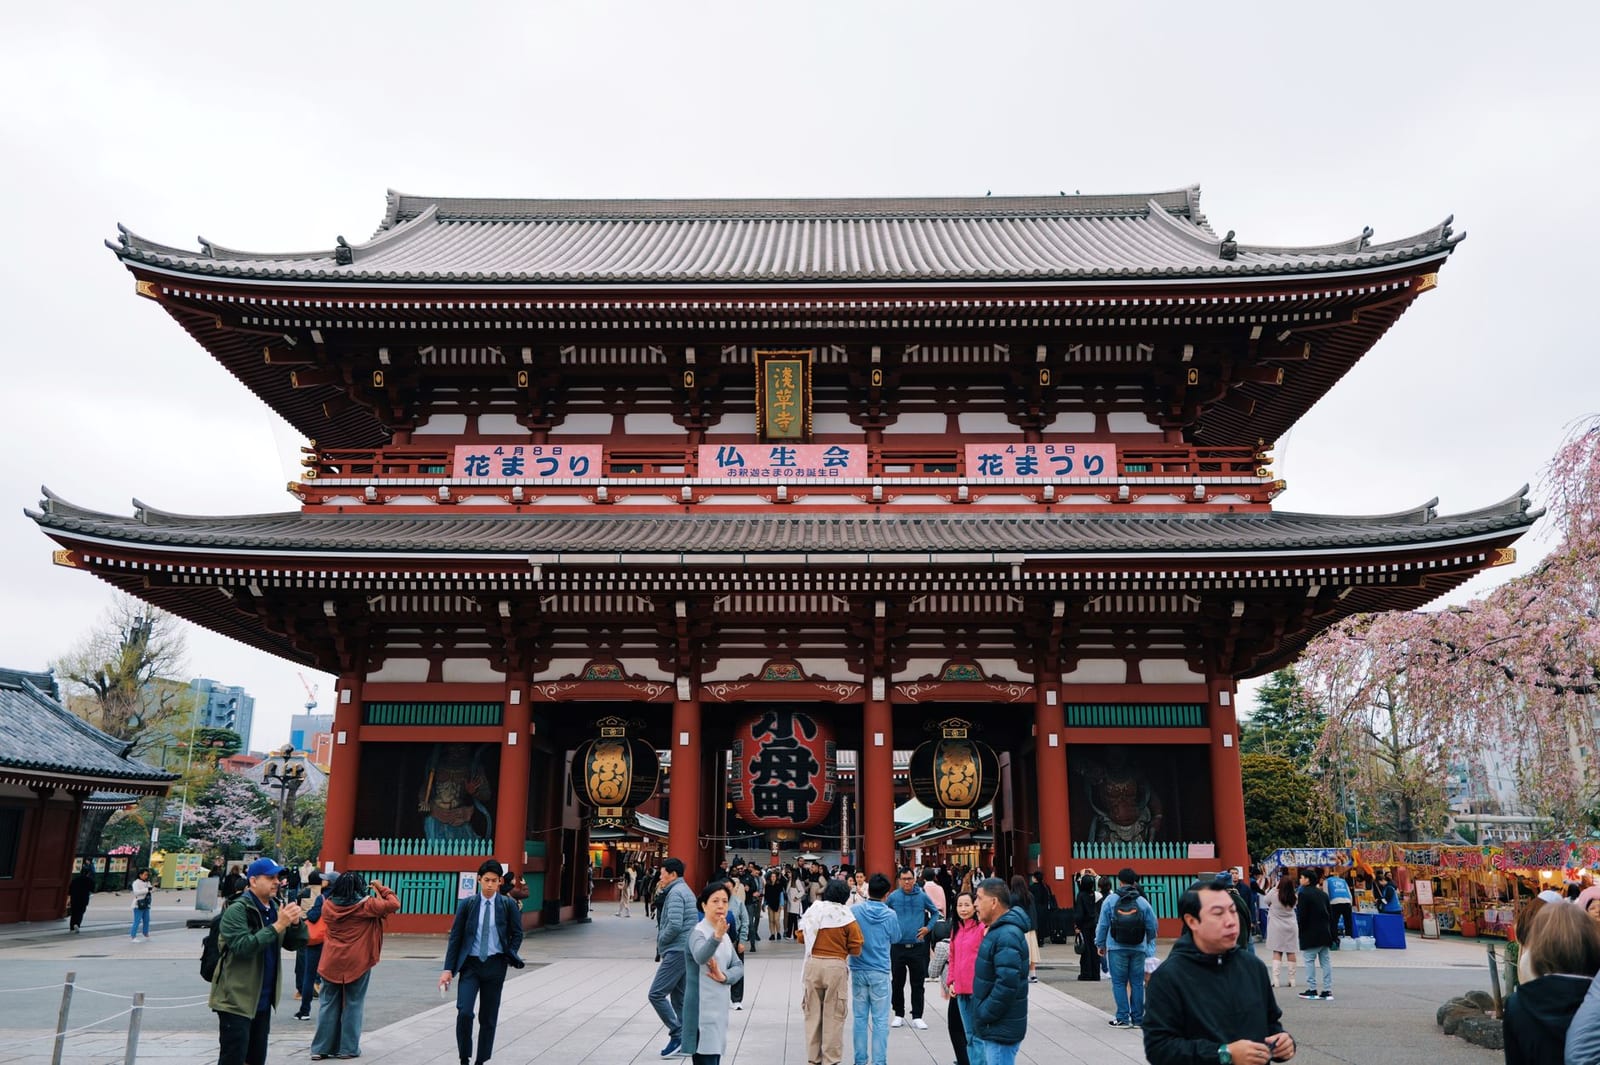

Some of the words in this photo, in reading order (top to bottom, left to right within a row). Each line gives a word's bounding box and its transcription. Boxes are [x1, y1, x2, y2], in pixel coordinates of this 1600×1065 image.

[493, 446, 562, 456] 4月8日
[715, 445, 850, 467] 仏生会
[1005, 445, 1075, 455] 4月8日
[464, 454, 589, 477] 花まつり
[727, 468, 839, 477] お釈迦さまのお誕生日
[977, 454, 1104, 476] 花まつり
[749, 708, 820, 824] 小舟町
